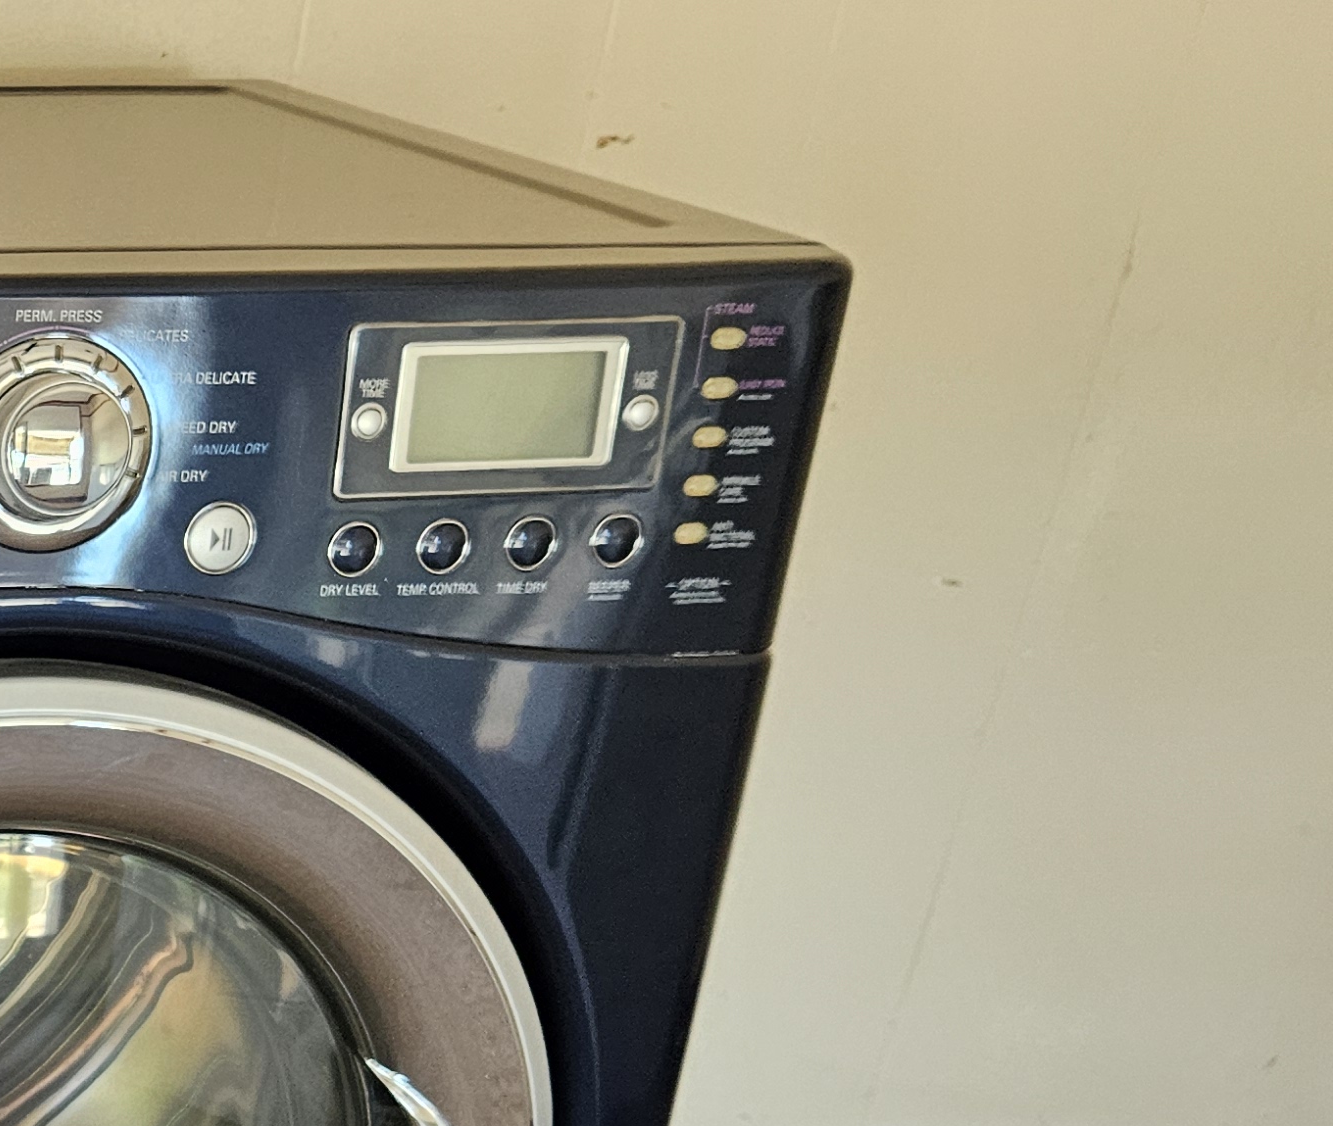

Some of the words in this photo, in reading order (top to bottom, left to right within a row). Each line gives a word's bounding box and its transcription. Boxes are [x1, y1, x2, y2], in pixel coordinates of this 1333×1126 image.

[15, 309, 57, 322] PERM.
[59, 309, 103, 322] PRESS
[195, 371, 257, 385] DELICATE
[209, 420, 236, 434] DRY
[192, 443, 242, 455] MANUAL
[244, 442, 269, 455] DRY
[180, 469, 208, 482] DRY
[319, 584, 344, 597] DRY
[345, 583, 381, 597] LEVEL
[428, 582, 481, 596] CONTROL
